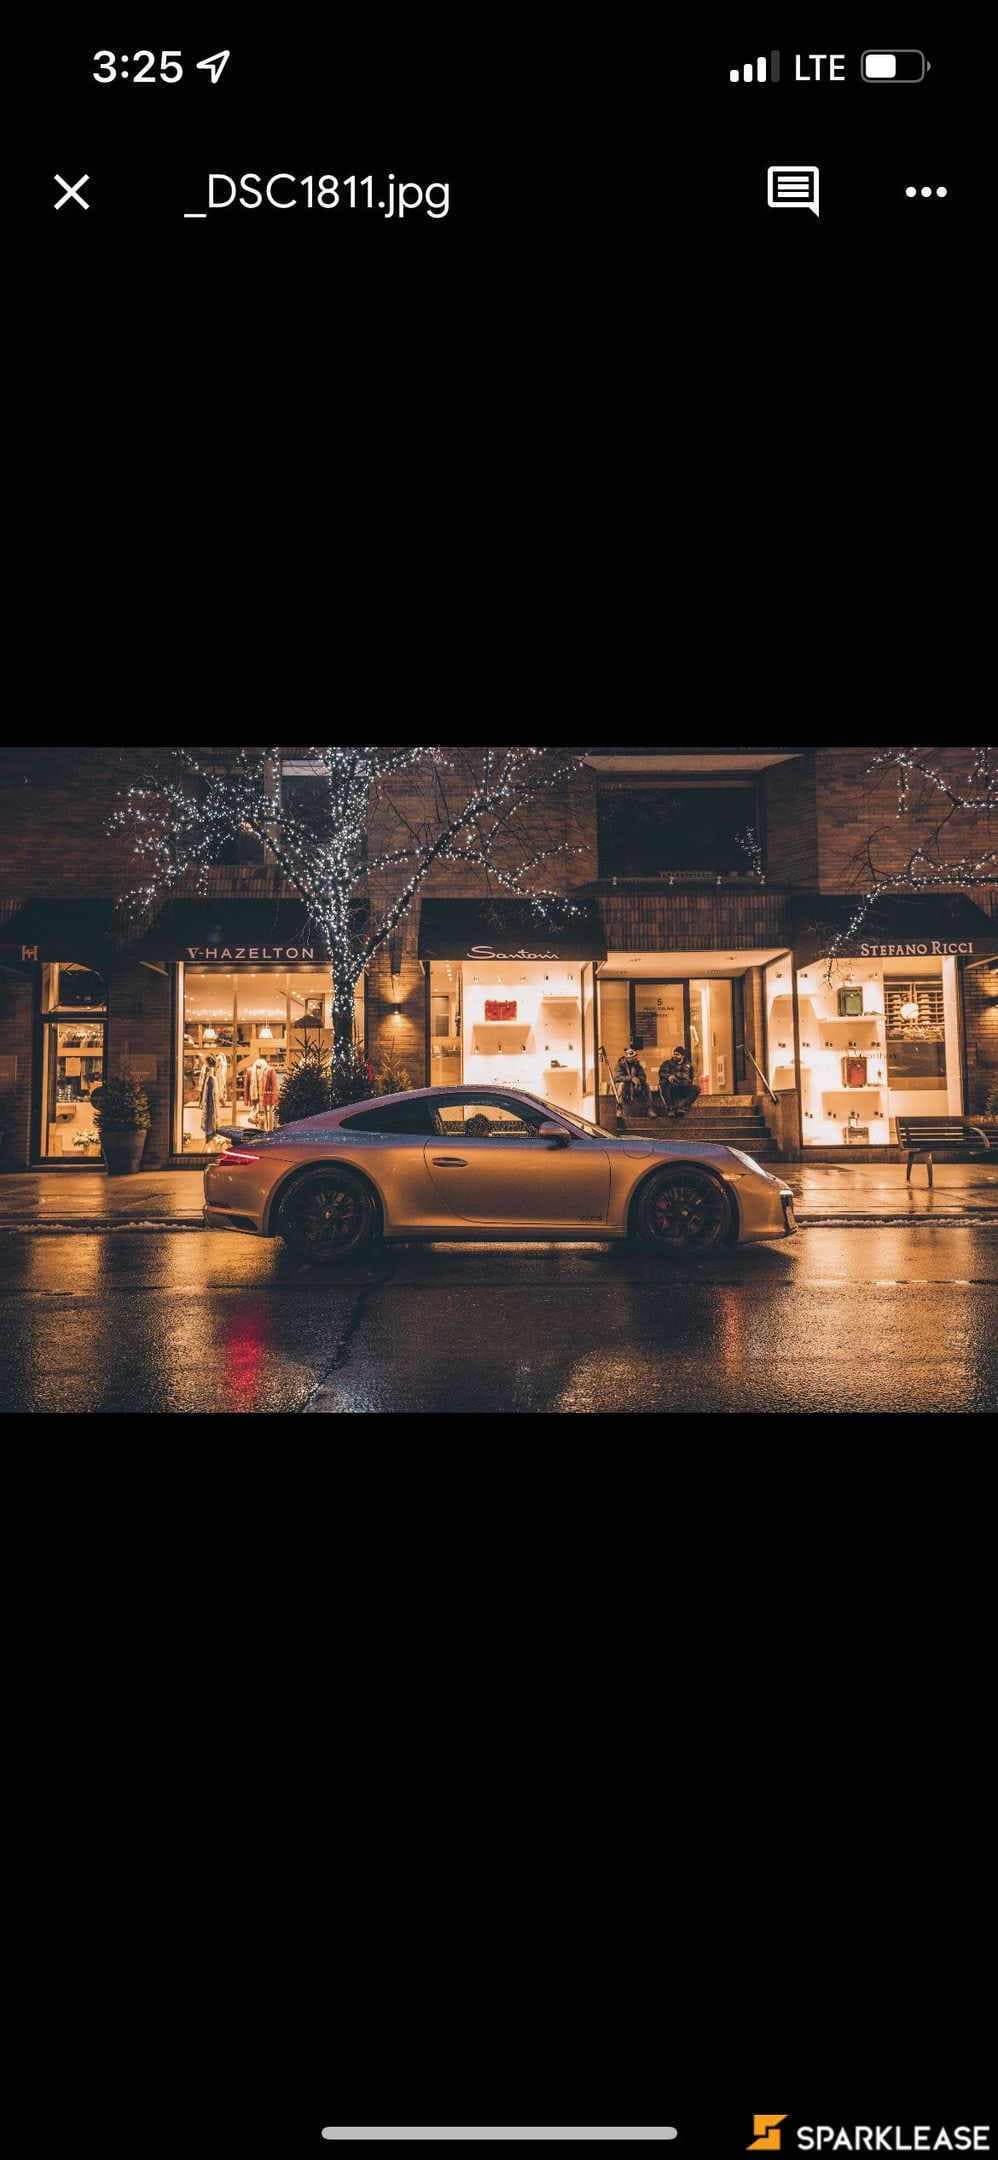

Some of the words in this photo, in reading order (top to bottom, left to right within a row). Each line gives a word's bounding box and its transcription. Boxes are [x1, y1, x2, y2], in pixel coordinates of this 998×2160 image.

[93, 50, 183, 83] 3:25
[796, 55, 846, 81] LTE
[184, 173, 450, 219] _DSC1811.jpg
[466, 945, 560, 960] Santoni
